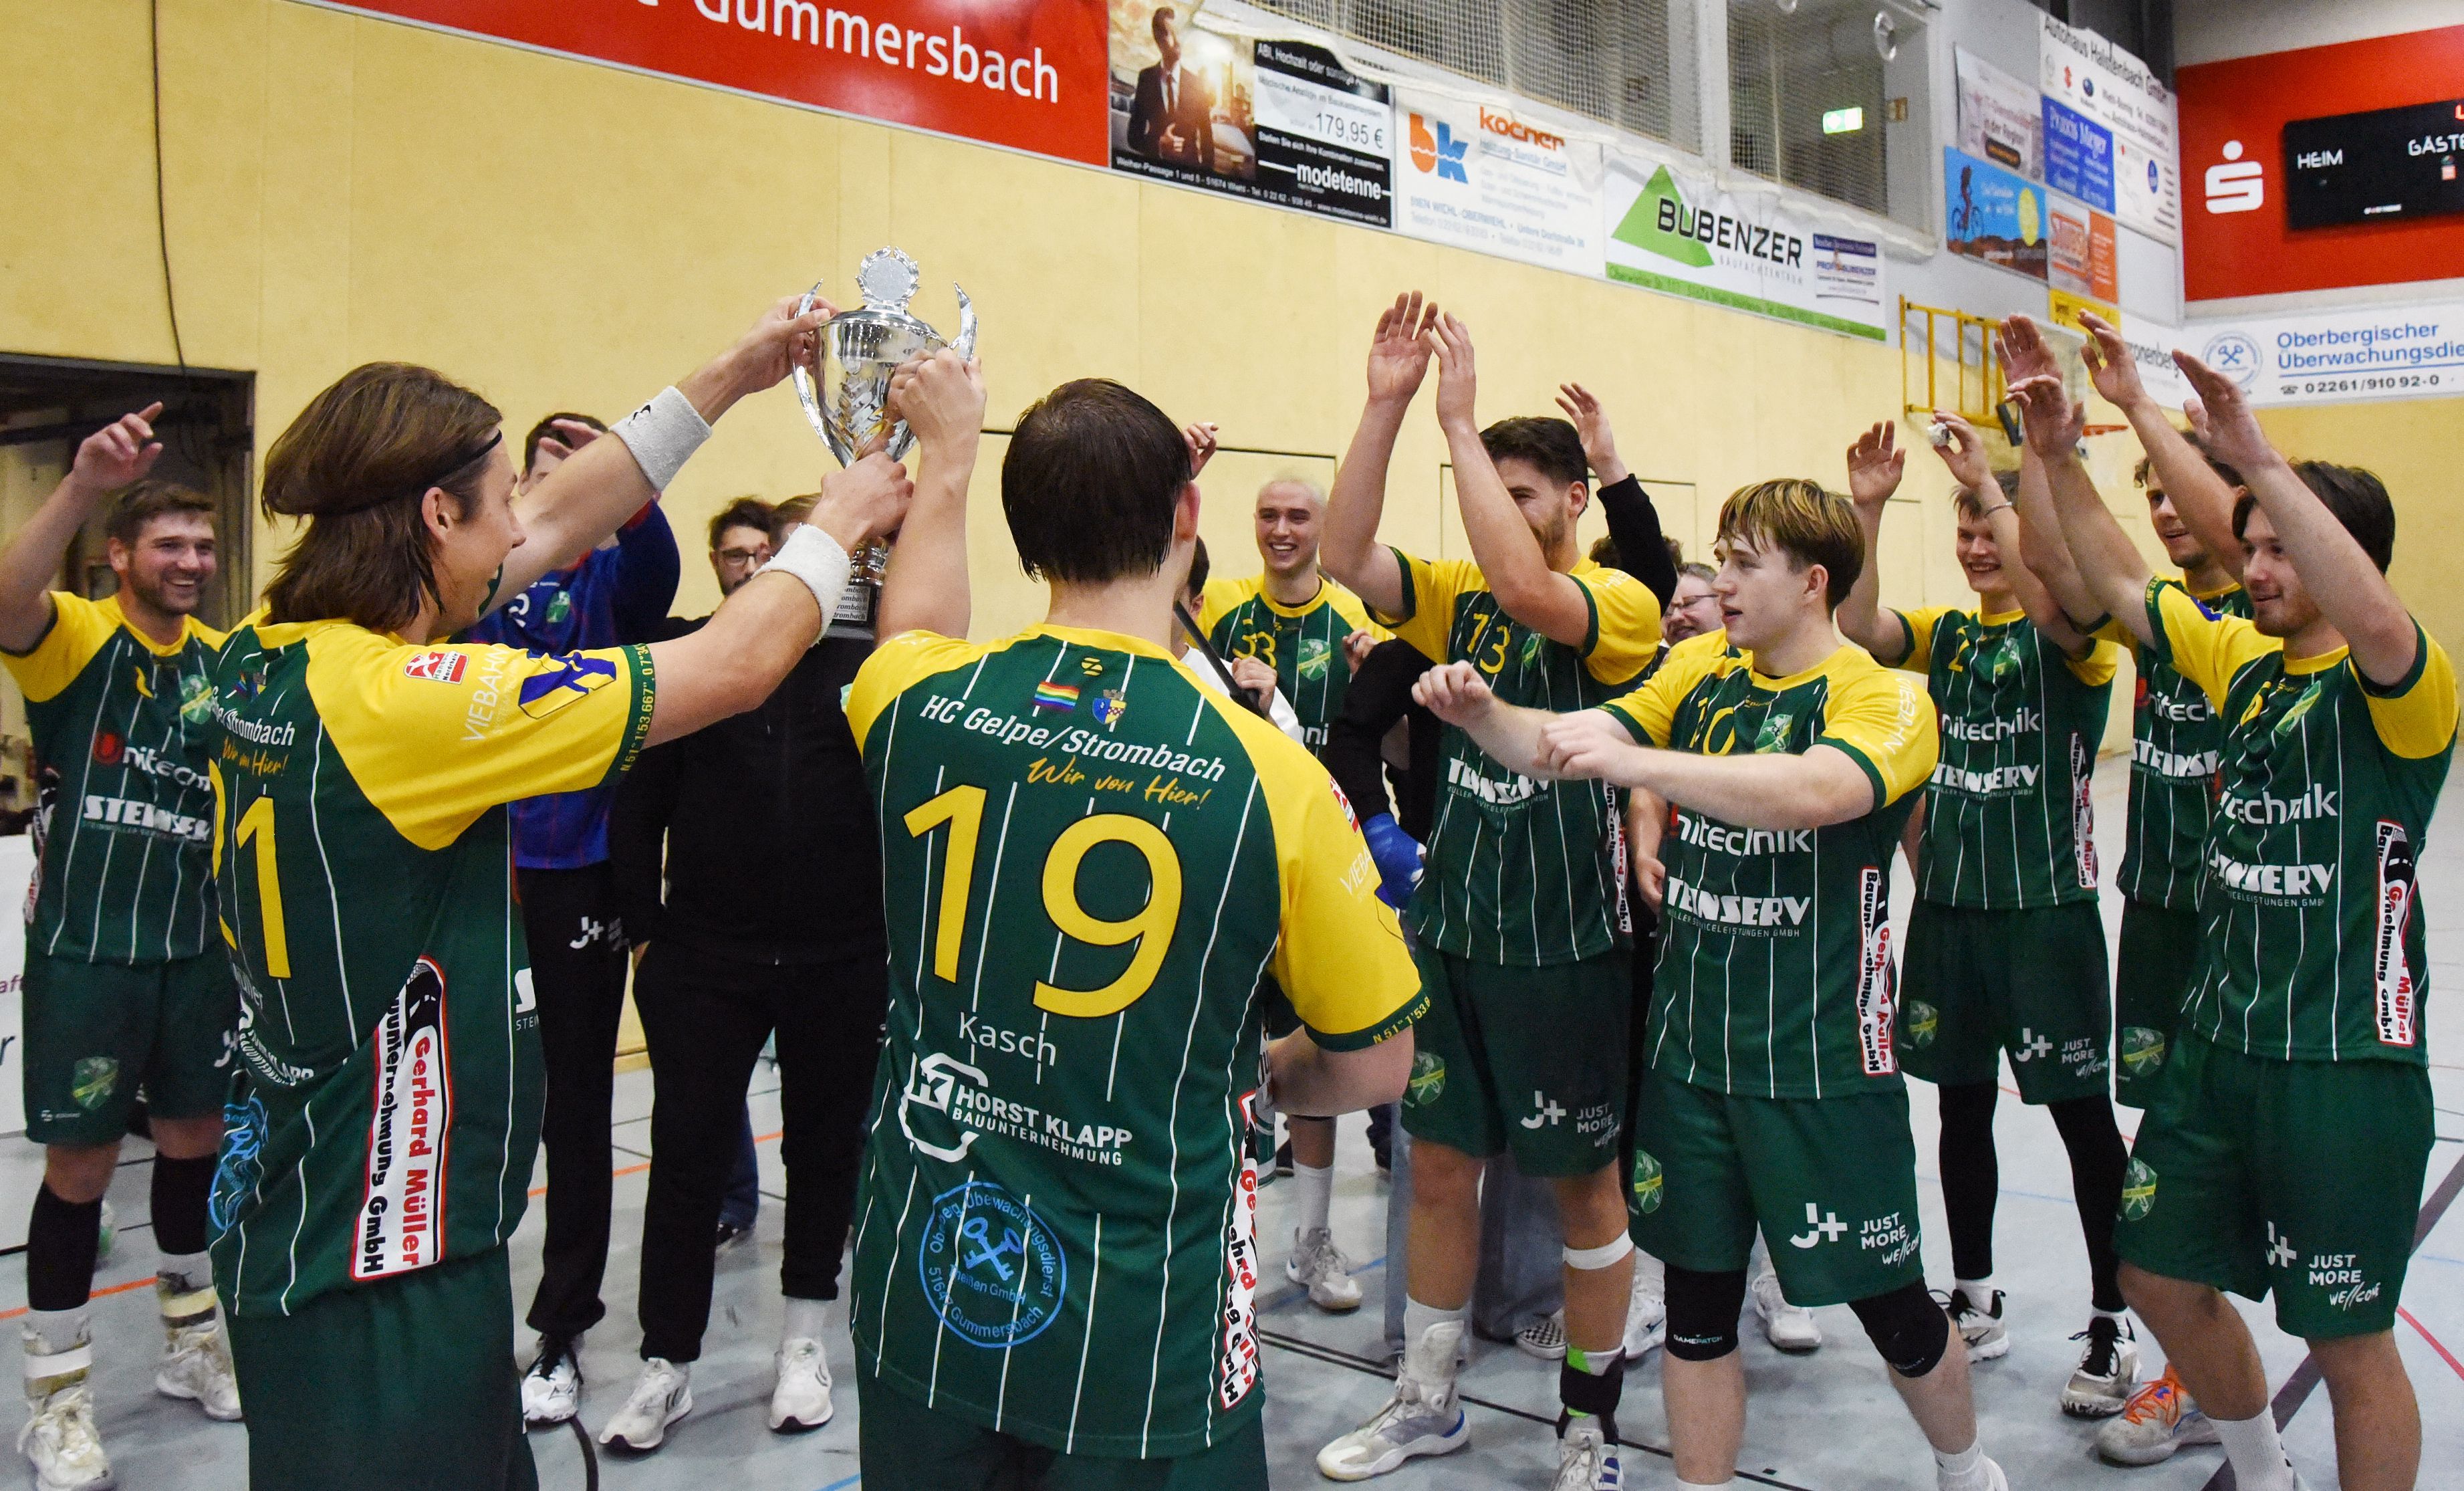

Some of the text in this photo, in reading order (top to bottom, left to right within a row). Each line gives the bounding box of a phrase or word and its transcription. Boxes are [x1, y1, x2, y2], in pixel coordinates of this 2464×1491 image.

[1316, 112, 1384, 149] 179,95 €
[1297, 163, 1382, 200] modetenne
[2298, 150, 2343, 170] HEIM
[1657, 198, 1803, 269] BUBENZER
[2277, 323, 2439, 350] Oberbergischer
[833, 612, 866, 620] trombach
[461, 647, 510, 742] VIEBAHN
[920, 695, 1226, 782] HC Gelpe/Strombach
[1689, 697, 1736, 756] 10
[1026, 756, 1213, 811] Wir von Hier!
[1339, 842, 1372, 895] VIEBA
[903, 783, 1183, 1018] 19
[959, 1011, 1057, 1066] Kasch
[2061, 1037, 2092, 1052] JUST
[2061, 1048, 2096, 1064] MORE
[955, 1084, 1133, 1149] HORST KLAPP
[1576, 1102, 1610, 1121] JUST
[402, 1036, 433, 1266] Gerhard Müller
[952, 1107, 1123, 1166] BAUUNTERNEHMUNG
[363, 1195, 388, 1274] GmbH
[1859, 1211, 1900, 1235] JUST
[1861, 1224, 1906, 1250] MORE
[2308, 1254, 2357, 1269] JUST
[2308, 1269, 2362, 1286] MORE
